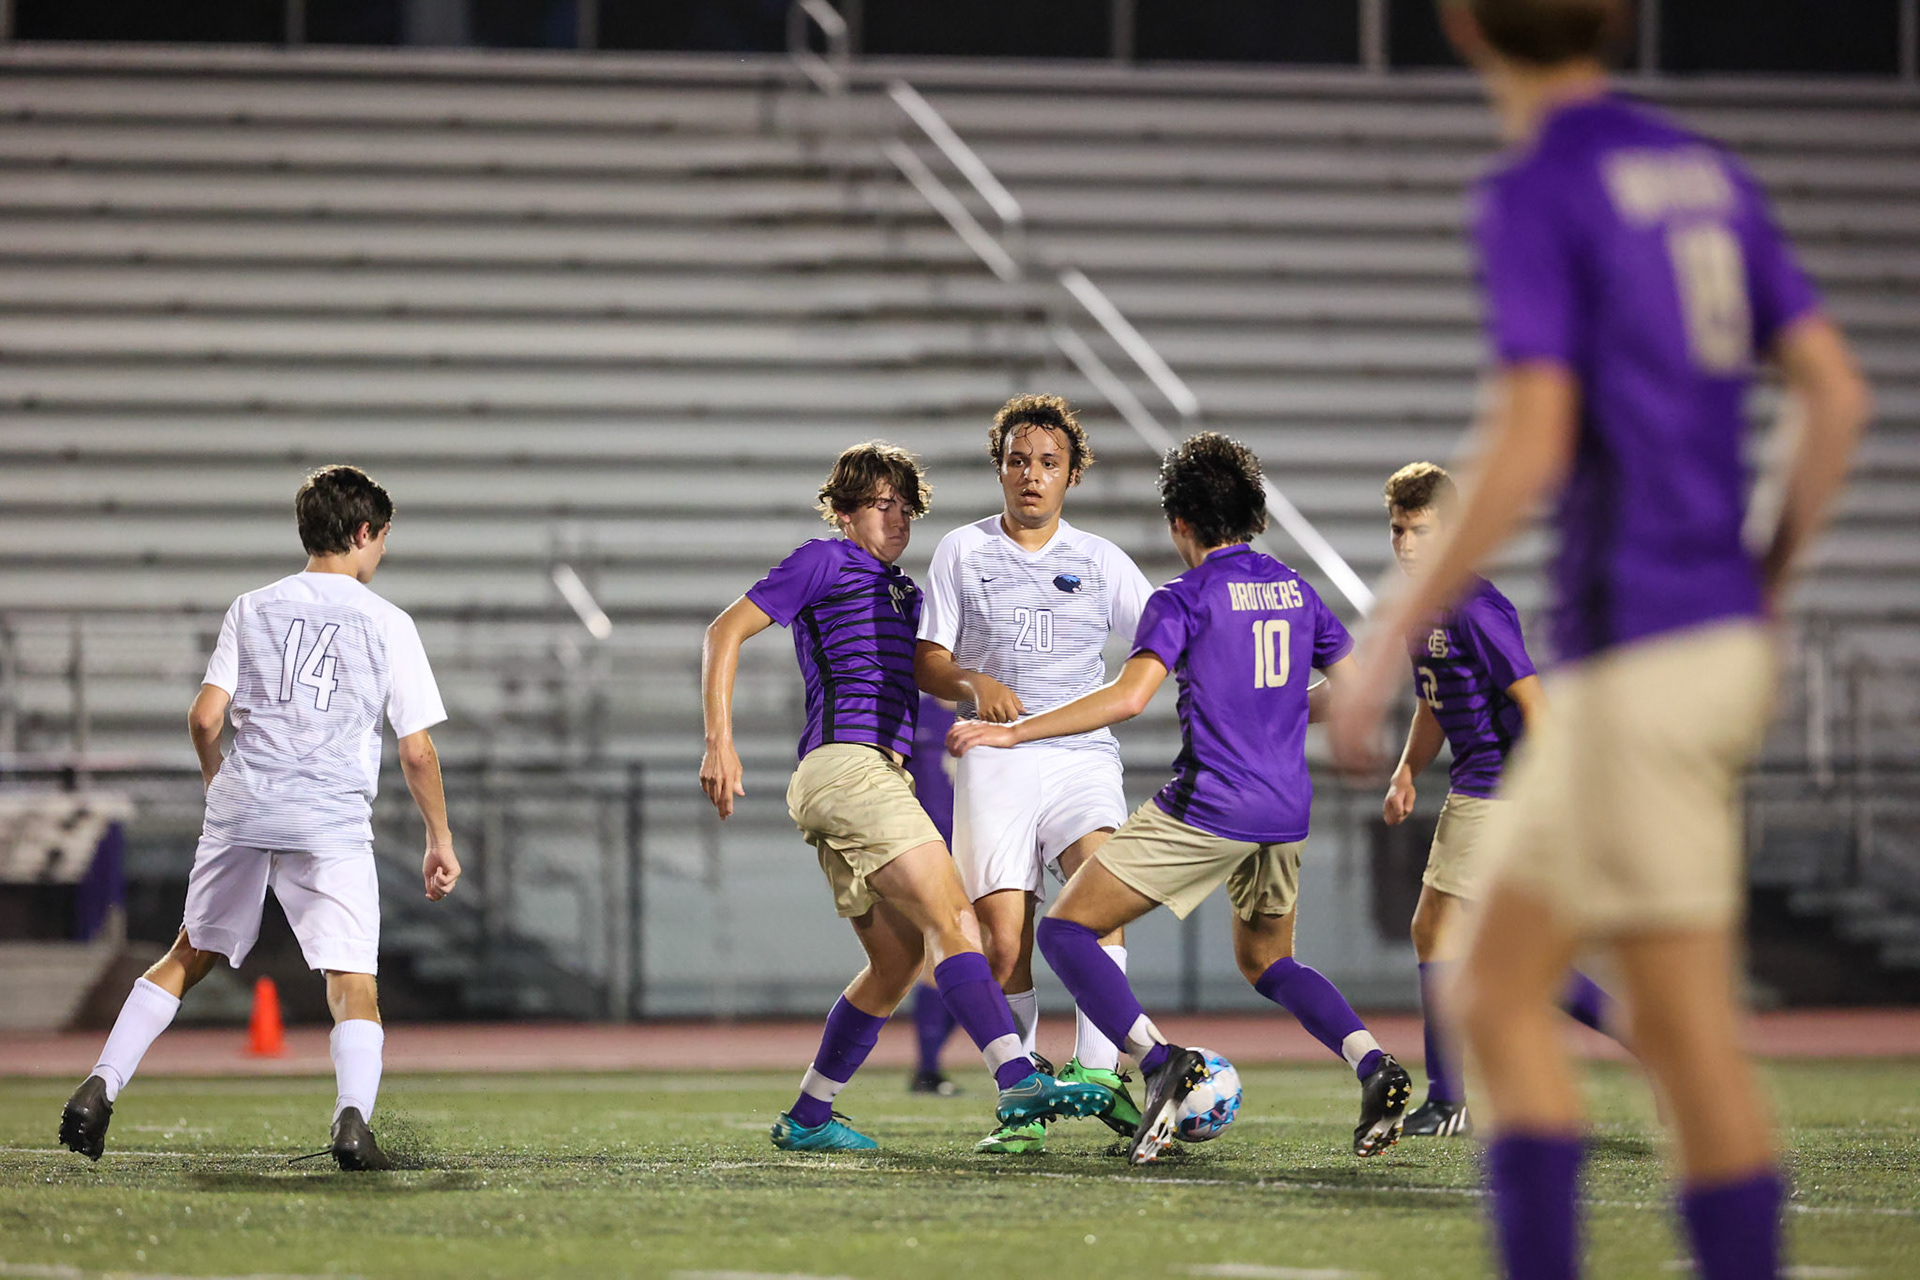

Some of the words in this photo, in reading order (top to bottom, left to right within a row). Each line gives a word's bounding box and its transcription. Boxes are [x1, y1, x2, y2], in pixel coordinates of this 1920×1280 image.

[1227, 579, 1304, 611] BROTHERS
[1013, 606, 1054, 653] 20
[1252, 619, 1291, 689] 10
[278, 617, 341, 713] 14
